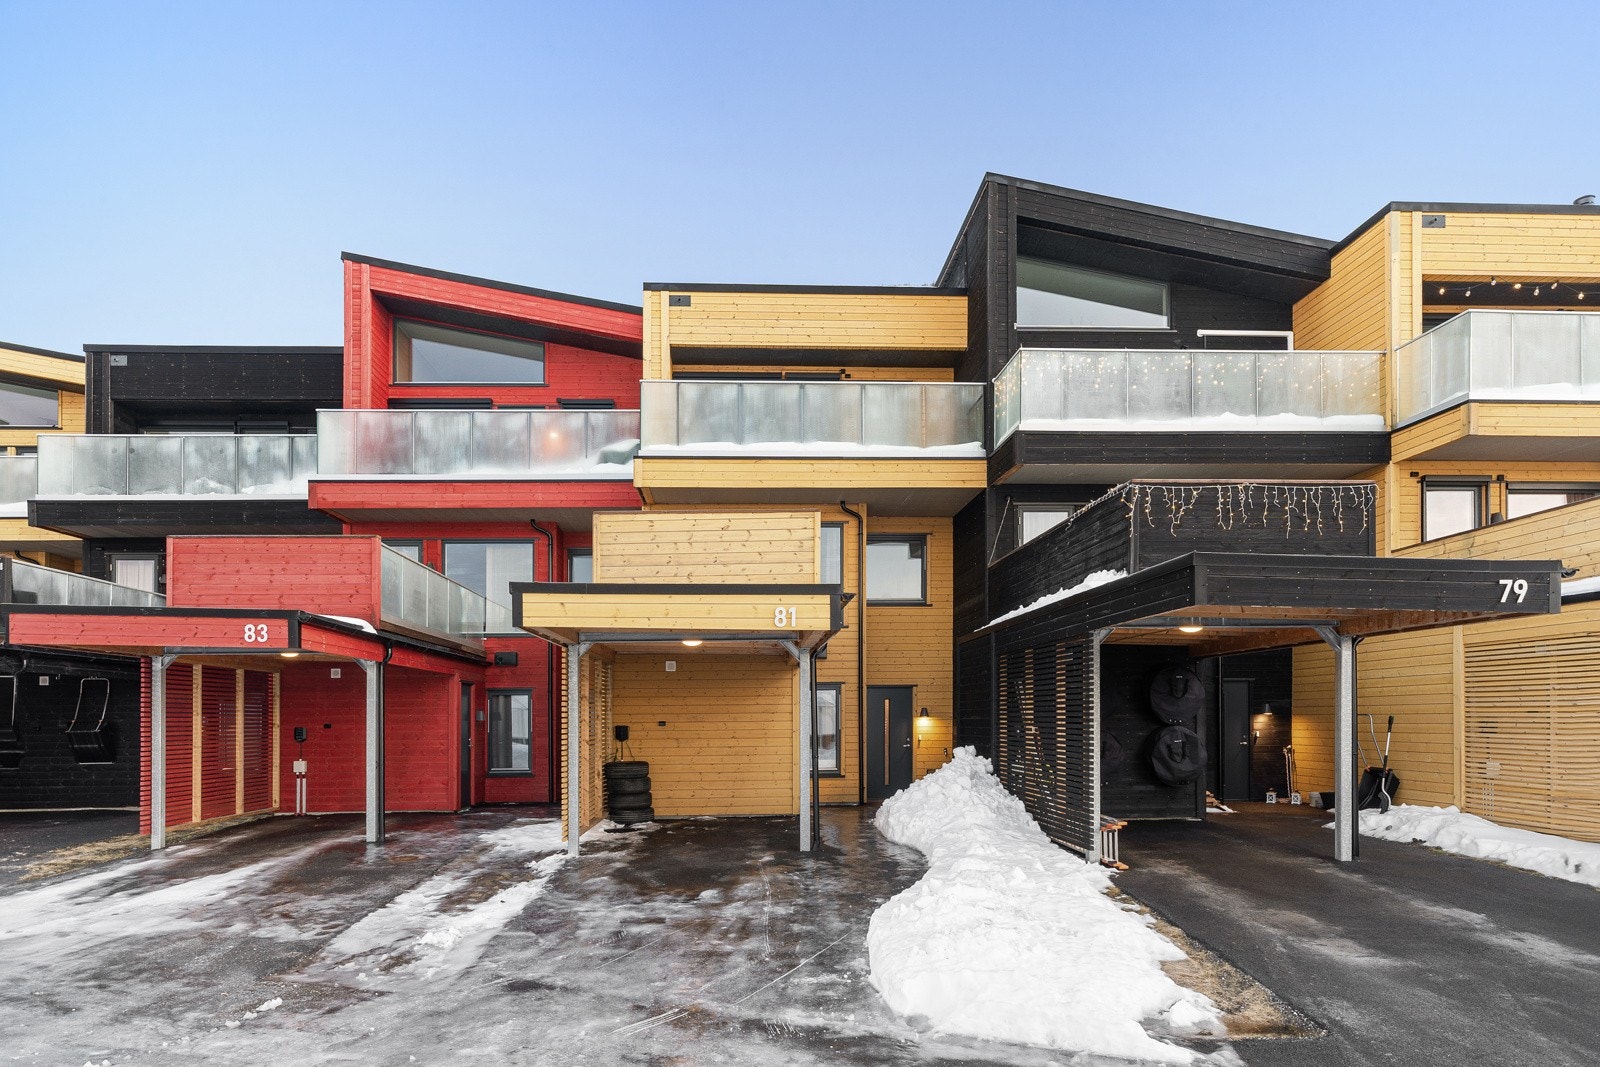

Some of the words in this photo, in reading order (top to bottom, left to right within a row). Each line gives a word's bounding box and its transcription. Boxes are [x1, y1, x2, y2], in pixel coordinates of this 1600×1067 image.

[1499, 579, 1528, 603] 79
[774, 606, 797, 628] 81
[244, 623, 268, 643] 83
